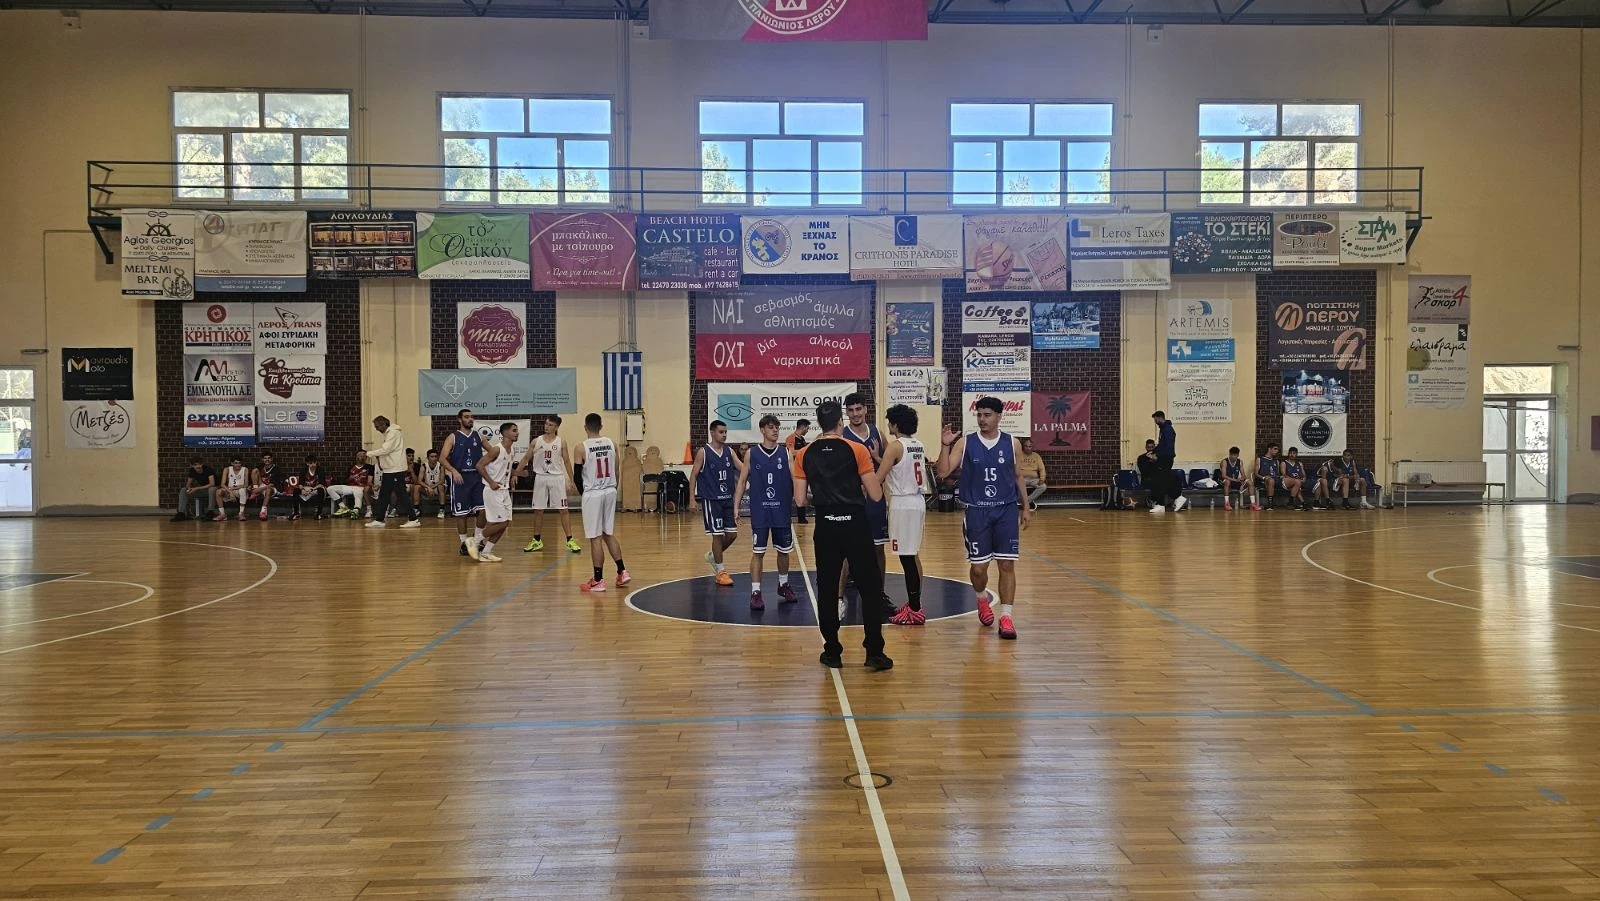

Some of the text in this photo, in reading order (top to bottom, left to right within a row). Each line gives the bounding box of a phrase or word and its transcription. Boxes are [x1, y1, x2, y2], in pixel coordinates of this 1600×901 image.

[749, 4, 837, 30] ΠΑΝΙΩΝΙΟΣ ΛΕΡΟΥ
[650, 216, 728, 225] BEACH HOTEL
[809, 221, 830, 229] ΜΗΝ
[1102, 226, 1165, 238] Leros Taxes
[1204, 222, 1226, 235] ΤΟ
[1230, 222, 1271, 235] ΣΤΕΚΙ
[643, 229, 735, 244] CASTELO
[802, 231, 837, 240] ΞΕΧΝΑΣ
[552, 242, 614, 253] με τσίπουρο
[704, 246, 718, 256] cafe
[726, 246, 738, 255] bar
[813, 242, 826, 250] ΤΟ
[1354, 243, 1376, 252] Super
[801, 253, 839, 261] ΚΡΑΝΟΣ
[911, 250, 959, 260] PARADISE
[704, 258, 738, 267] restaurant
[124, 265, 172, 273] MELTEMI
[704, 270, 718, 278] rent
[137, 275, 159, 284] BAR
[754, 292, 814, 315] σεβασμός
[814, 300, 855, 318] άμιλλα
[1430, 299, 1457, 310] σκορ
[713, 298, 744, 325] ΝΑΙ
[964, 304, 1013, 318] Coffee
[764, 315, 836, 329] αθλητισμός
[999, 316, 1029, 325] Bean
[1169, 317, 1230, 328] ARTEMIS
[1305, 311, 1360, 323] ΛΕΡΟΥ
[258, 321, 288, 329] ΛΕΡΟΣ
[184, 330, 252, 343] ΚΡΗΤΙΚΟΣ
[259, 331, 318, 339] ΑΦΟΙ ΣΥΡΙΔΑΚΗ
[467, 328, 517, 342] Mikes
[265, 341, 316, 349] ΜΕΤΑΦΟΡΙΚΗ
[757, 337, 778, 356] βία
[810, 335, 854, 351] αλκοόλ
[713, 342, 745, 369] ΟΧΙ
[773, 353, 841, 368] ναρκωτικά
[966, 358, 1015, 368] KASTIS
[268, 374, 279, 385] Τα
[186, 385, 238, 396] ΕΜΜΑΝΟΥΗΛ
[424, 400, 488, 410] Germanos Group
[760, 396, 809, 407] ΟΠΤΙΚΑ
[187, 413, 252, 427] express
[263, 407, 319, 422] Leros
[1034, 423, 1088, 432] LA PALMA
[544, 450, 552, 459] 10
[596, 457, 611, 479] 11
[913, 461, 923, 486] 6
[718, 470, 727, 480] 10
[767, 472, 774, 485] 8
[984, 467, 997, 482] 15
[892, 539, 898, 552] 6
